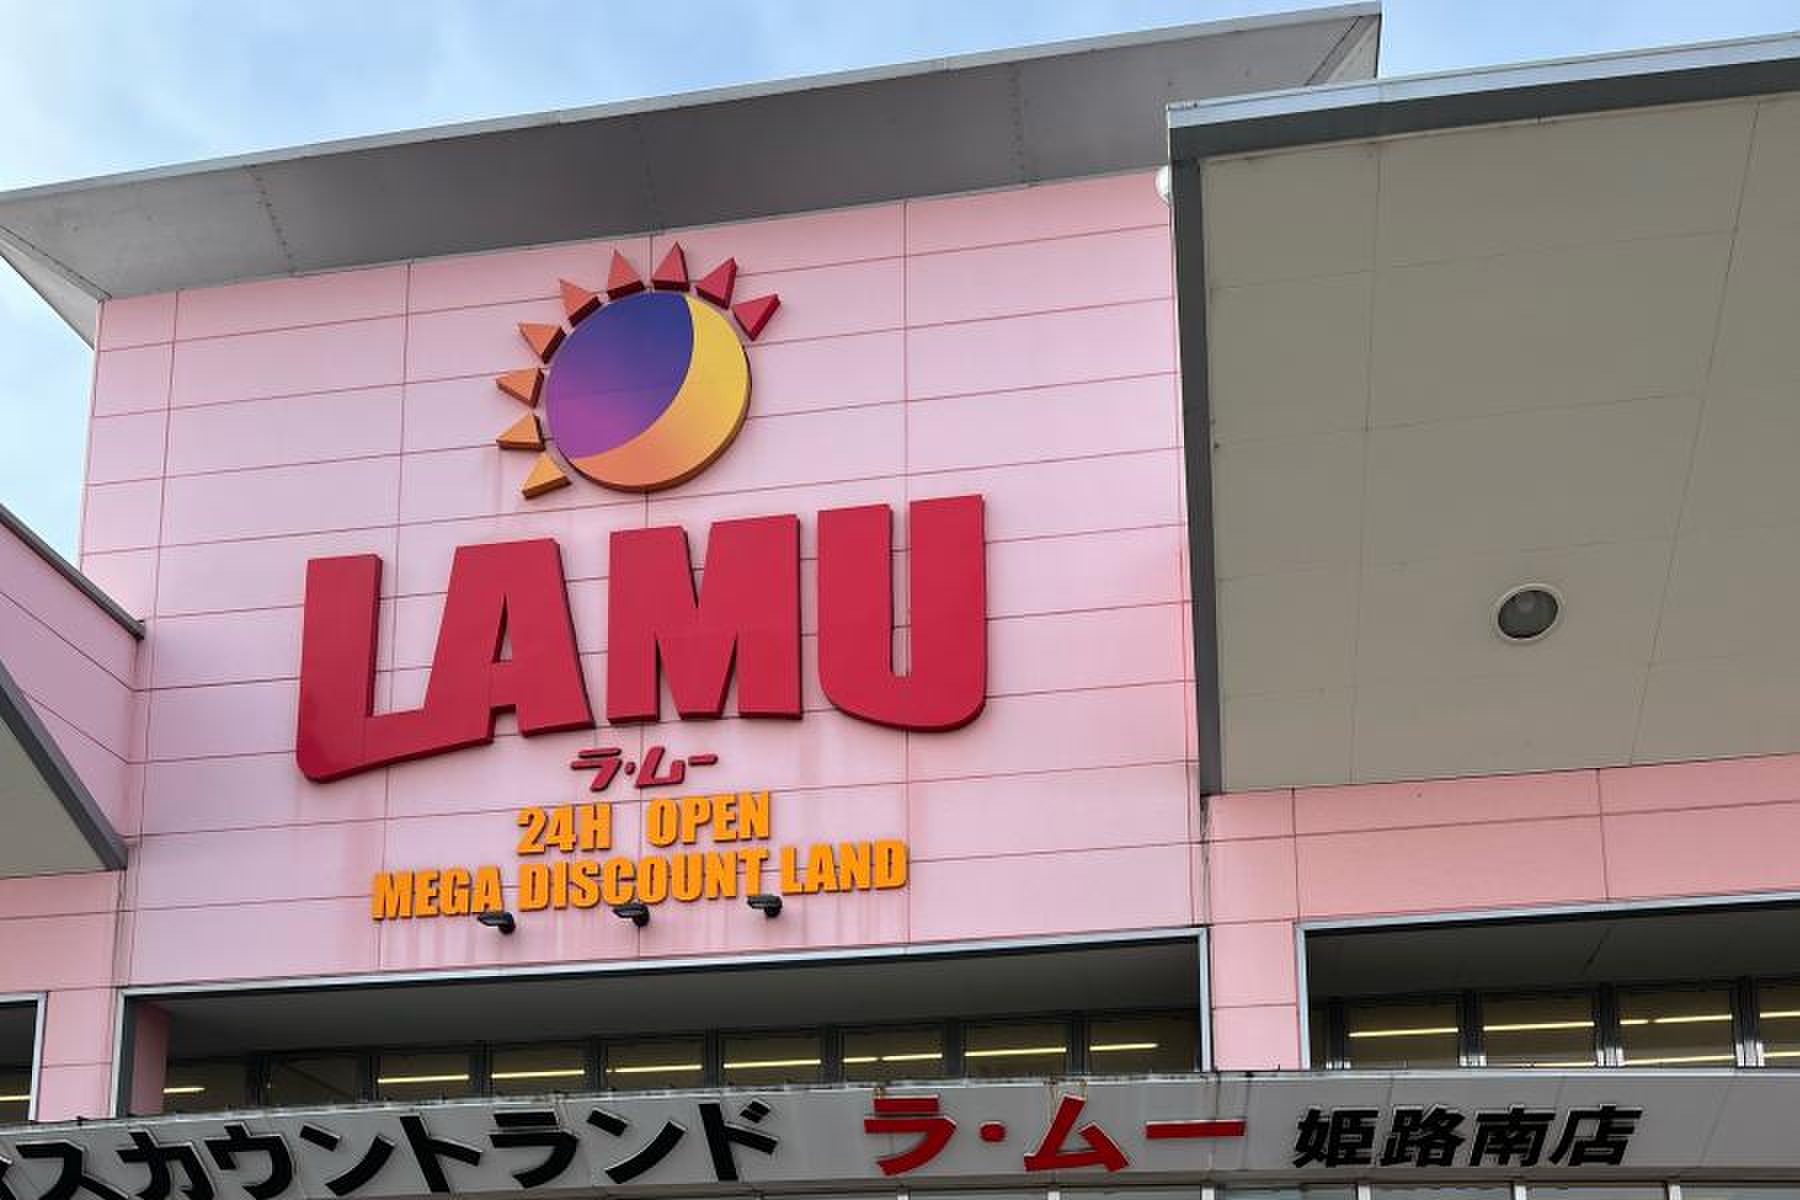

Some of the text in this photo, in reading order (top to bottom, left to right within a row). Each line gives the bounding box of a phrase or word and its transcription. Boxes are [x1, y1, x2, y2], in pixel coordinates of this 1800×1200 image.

[297, 494, 988, 783] LAMU
[517, 792, 770, 854] 24H OPEN
[372, 840, 908, 920] MEGA DISCOUNT LAND
[1294, 1106, 1643, 1168] 姫路南店
